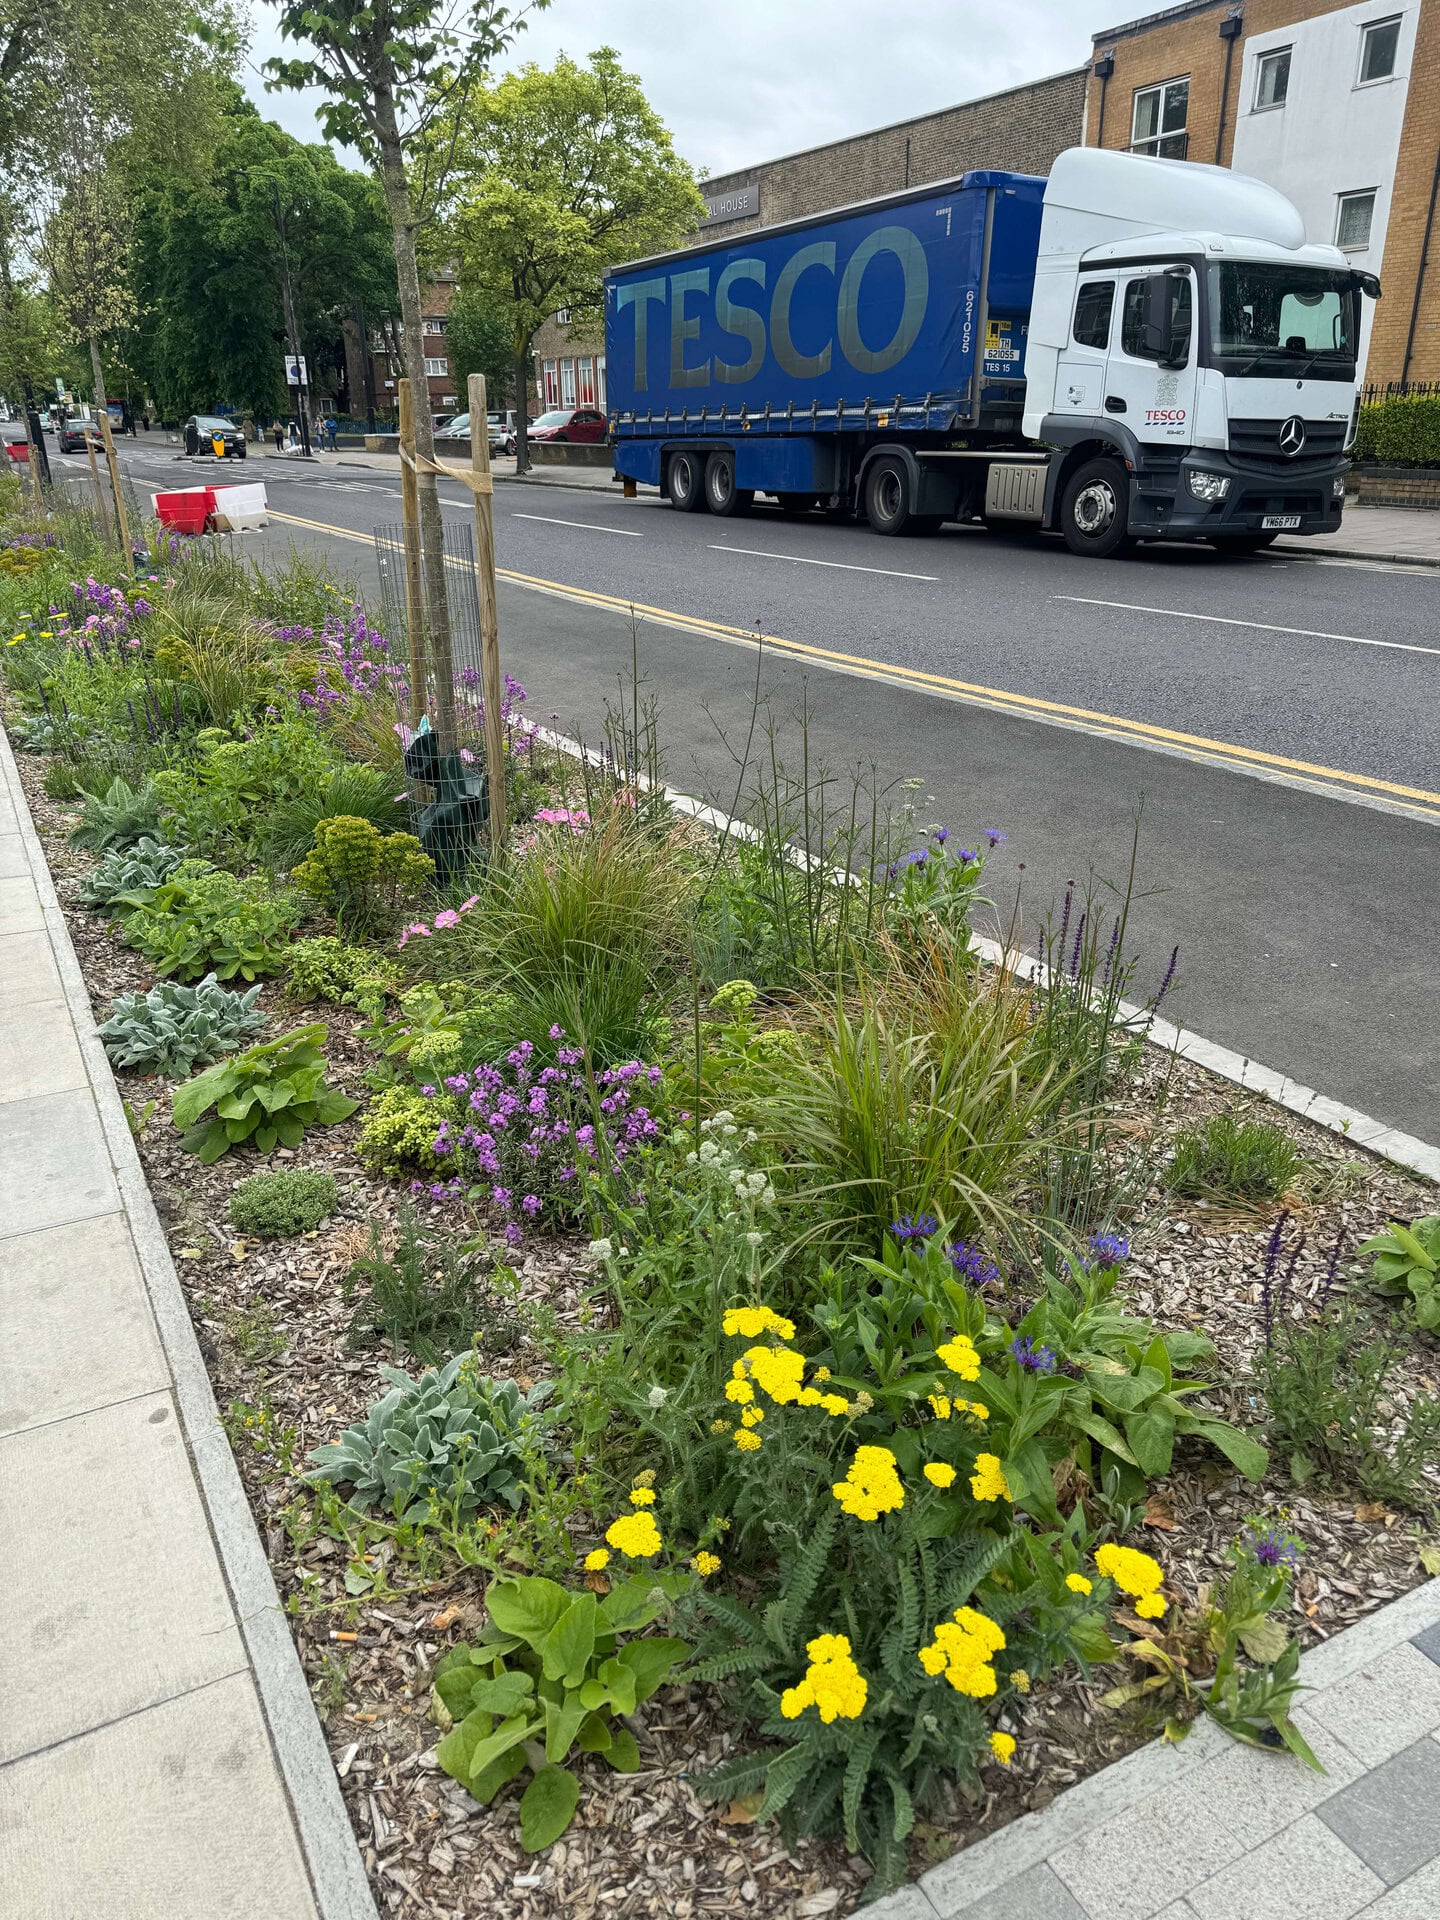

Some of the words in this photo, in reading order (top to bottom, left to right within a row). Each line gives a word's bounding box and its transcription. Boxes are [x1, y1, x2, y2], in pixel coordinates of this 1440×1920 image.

[720, 195, 748, 214] HOUSE
[617, 226, 929, 392] TESCO
[962, 290, 974, 353] 621055
[1001, 339, 1010, 349] TH
[988, 349, 1014, 359] 621055
[985, 362, 1000, 372] TES
[1003, 363, 1010, 372] 15
[1145, 409, 1186, 421] TESCO
[1266, 517, 1284, 527] YM66
[1284, 517, 1299, 527] PTX
